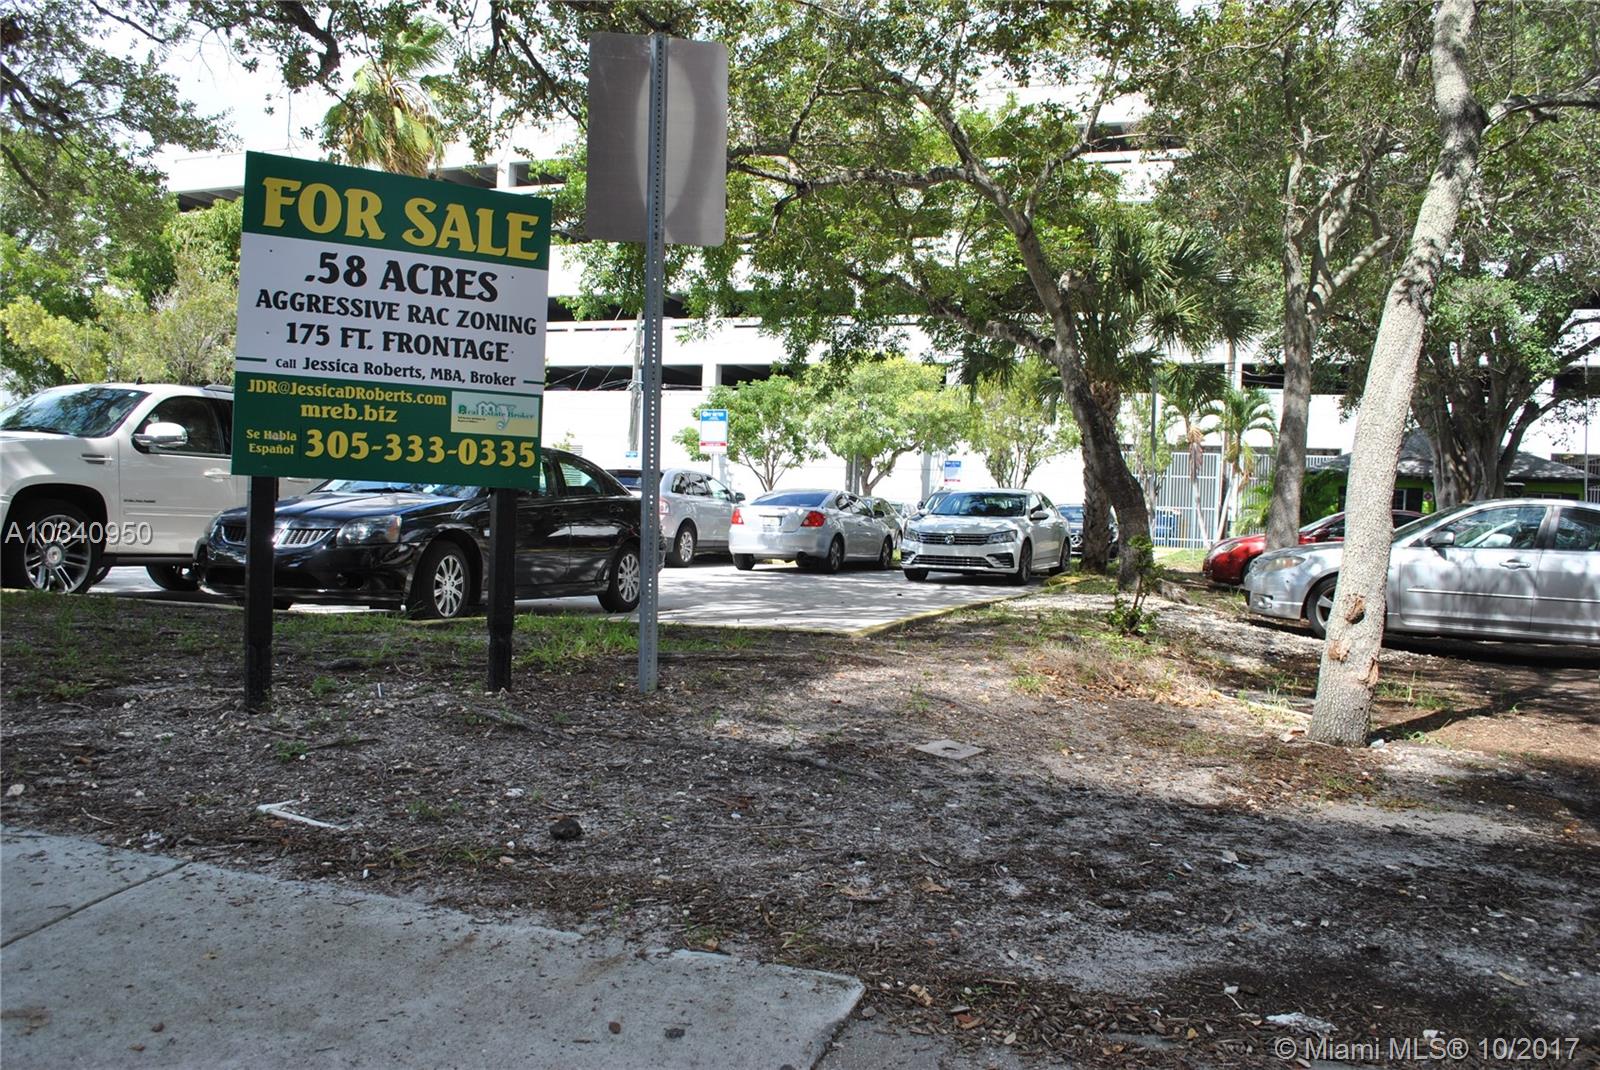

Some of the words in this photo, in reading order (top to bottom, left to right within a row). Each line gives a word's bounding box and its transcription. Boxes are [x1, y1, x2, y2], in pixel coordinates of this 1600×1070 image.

[262, 177, 386, 241] FOR
[402, 197, 539, 261] SALE
[304, 252, 367, 287] .58
[379, 259, 498, 302] ACRES
[255, 288, 399, 321] AGGRESSIVE
[407, 304, 449, 326] RAC
[456, 308, 537, 336] ZONING
[286, 322, 330, 346] 175
[340, 326, 374, 350] FT.
[382, 331, 510, 362] FRONTAGE
[275, 358, 297, 370] Call
[302, 357, 359, 374] Jessica
[363, 362, 426, 381] Roberts,
[430, 367, 466, 384] MBA,
[470, 370, 516, 387] Broker
[247, 378, 447, 406] JDR@JessicaDRoberts.com
[300, 402, 398, 423] mreb.biz
[245, 428, 260, 440] Se
[263, 430, 297, 441] Habla
[248, 442, 294, 455] Español
[304, 428, 536, 468] 305-333-0335
